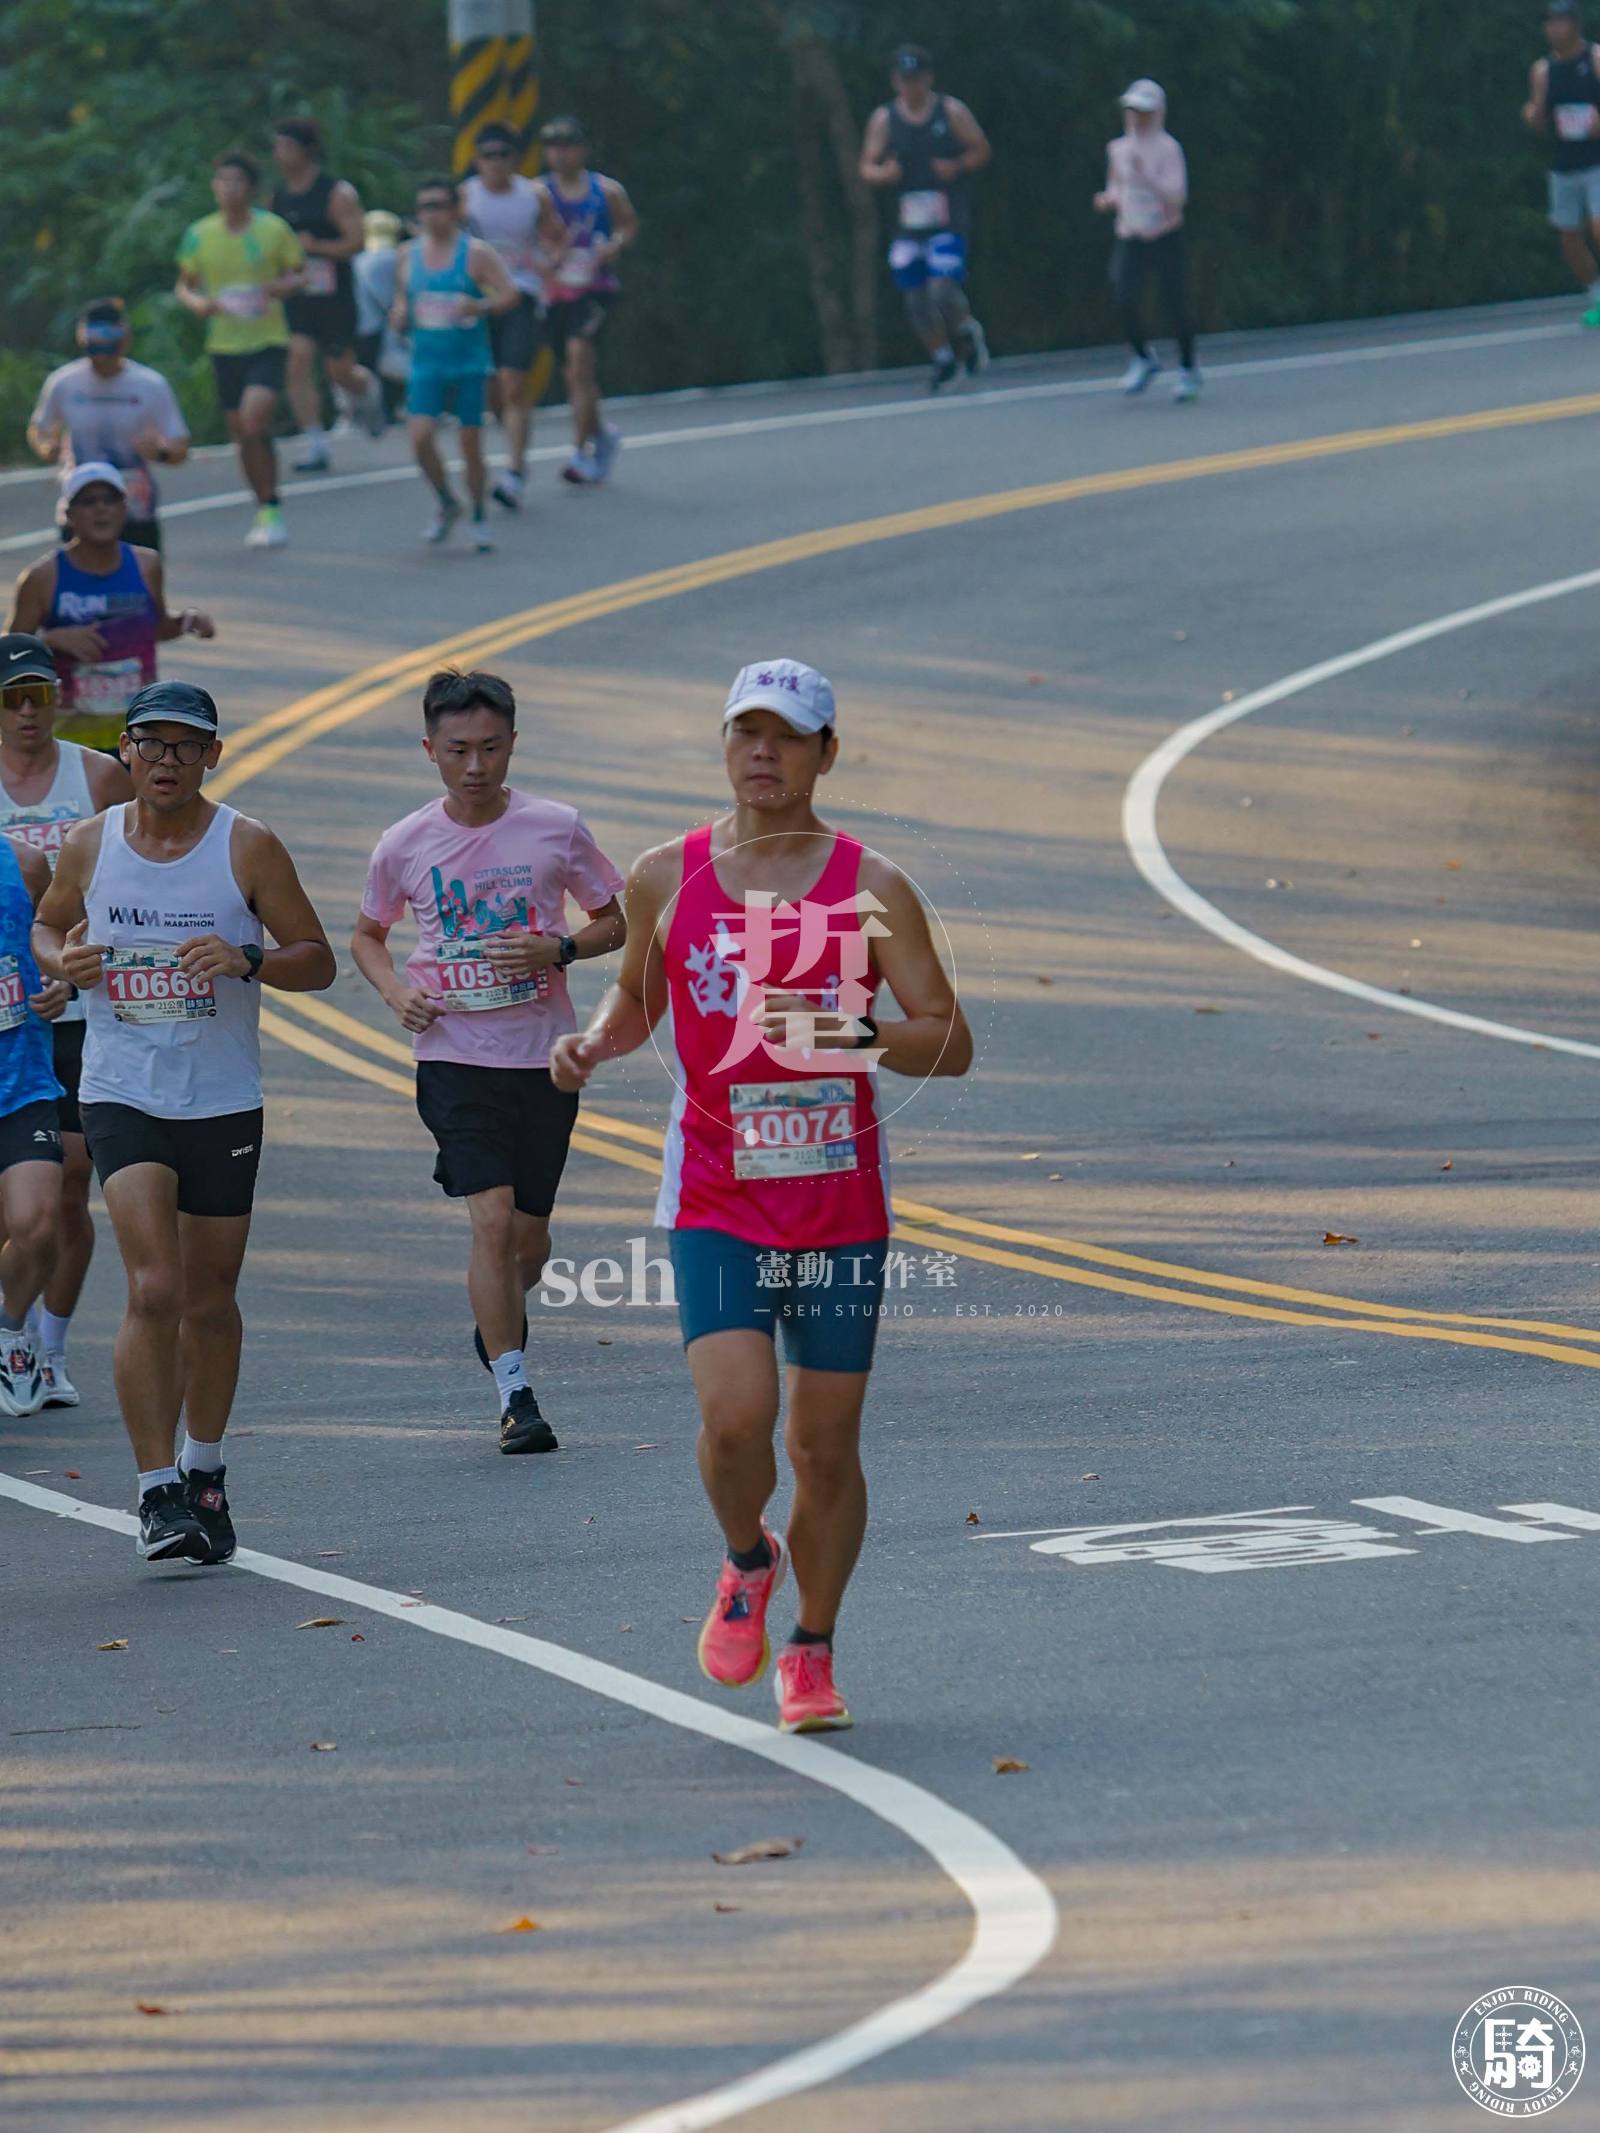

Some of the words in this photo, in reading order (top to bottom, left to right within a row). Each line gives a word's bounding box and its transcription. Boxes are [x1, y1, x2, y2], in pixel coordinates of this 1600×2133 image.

[473, 864, 532, 879] CITTASLOW
[474, 880, 498, 891] HILL
[501, 877, 533, 889] CLIMB
[164, 920, 214, 928] MARATHON
[736, 1107, 852, 1148] 10074
